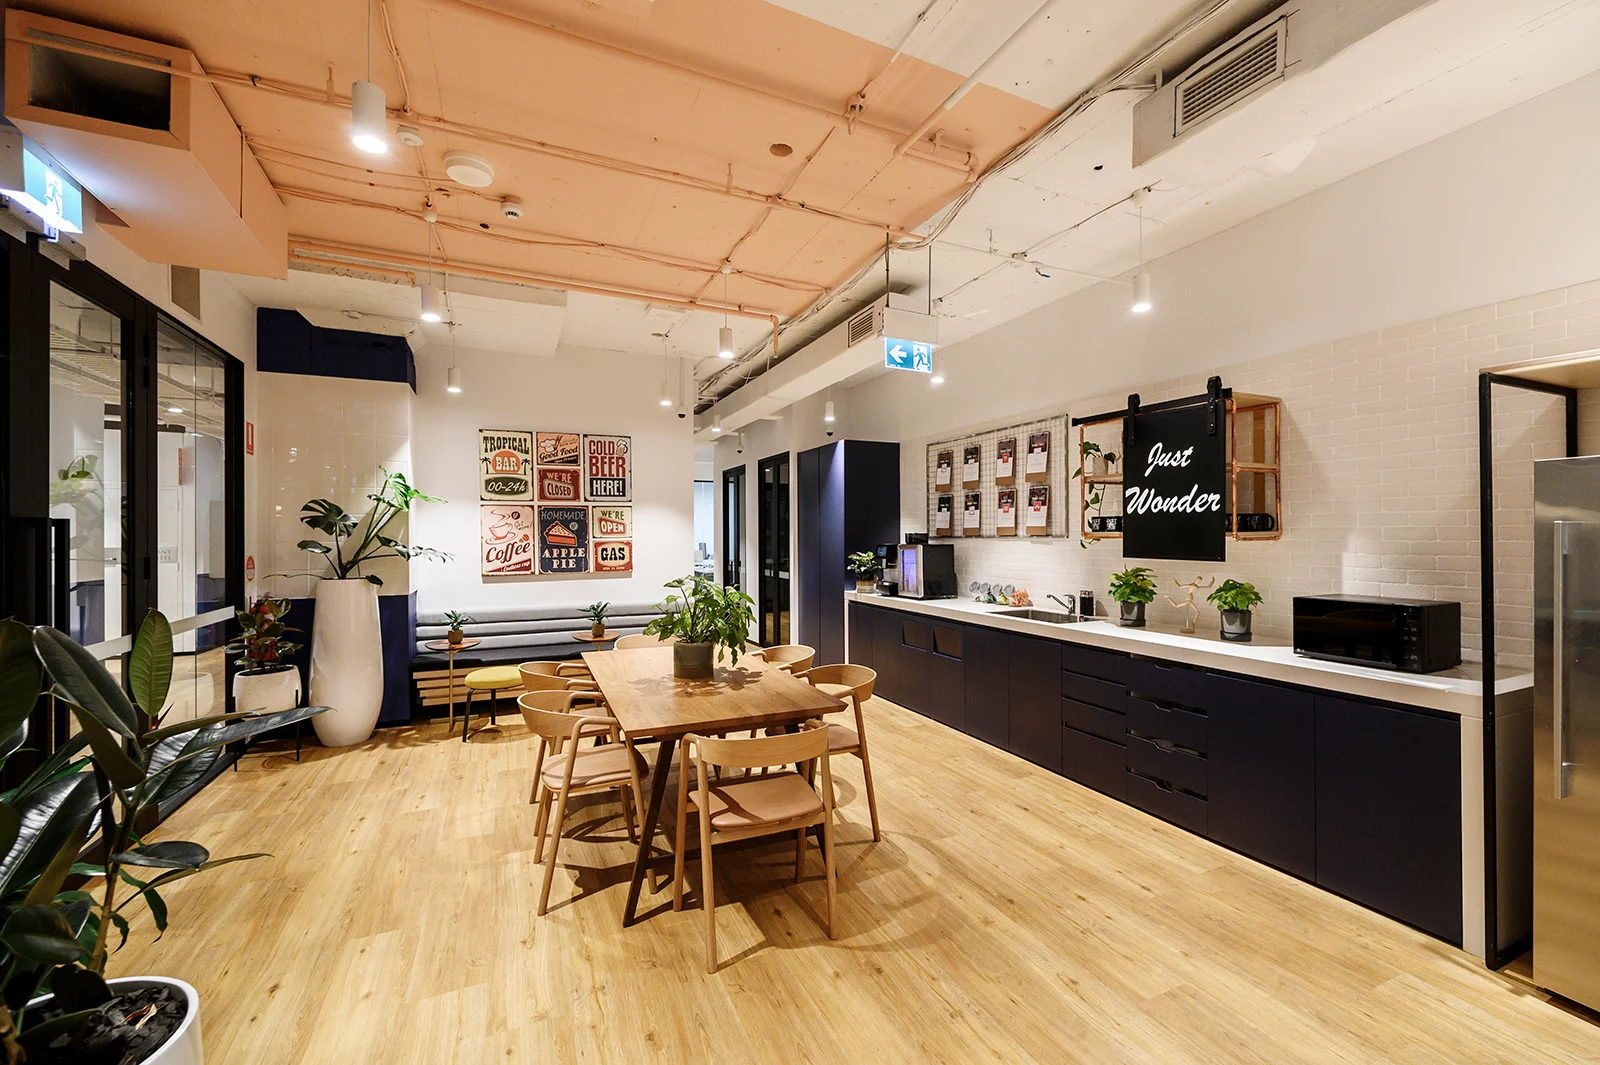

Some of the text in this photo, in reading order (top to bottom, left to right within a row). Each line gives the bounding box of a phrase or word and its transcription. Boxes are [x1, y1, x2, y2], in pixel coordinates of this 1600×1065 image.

[482, 436, 530, 455] TROPICAL
[589, 440, 615, 455] COLD
[539, 450, 559, 462] Good
[560, 445, 578, 456] Food
[1144, 442, 1194, 477] Just
[495, 456, 518, 471] BAR
[589, 455, 626, 477] BEER
[546, 472, 572, 484] WE'RE
[488, 480, 527, 492] 00-24h
[547, 482, 572, 496] CLOSED
[593, 480, 623, 496] HERE!
[1125, 484, 1221, 515] Wonder
[541, 510, 585, 520] HOMEMADE
[600, 510, 625, 521] WE'RE
[601, 520, 625, 533] OPEN
[486, 541, 531, 564] Coffee
[542, 548, 586, 558] APPLE
[600, 547, 626, 561] GAS
[552, 559, 577, 569] PIE
